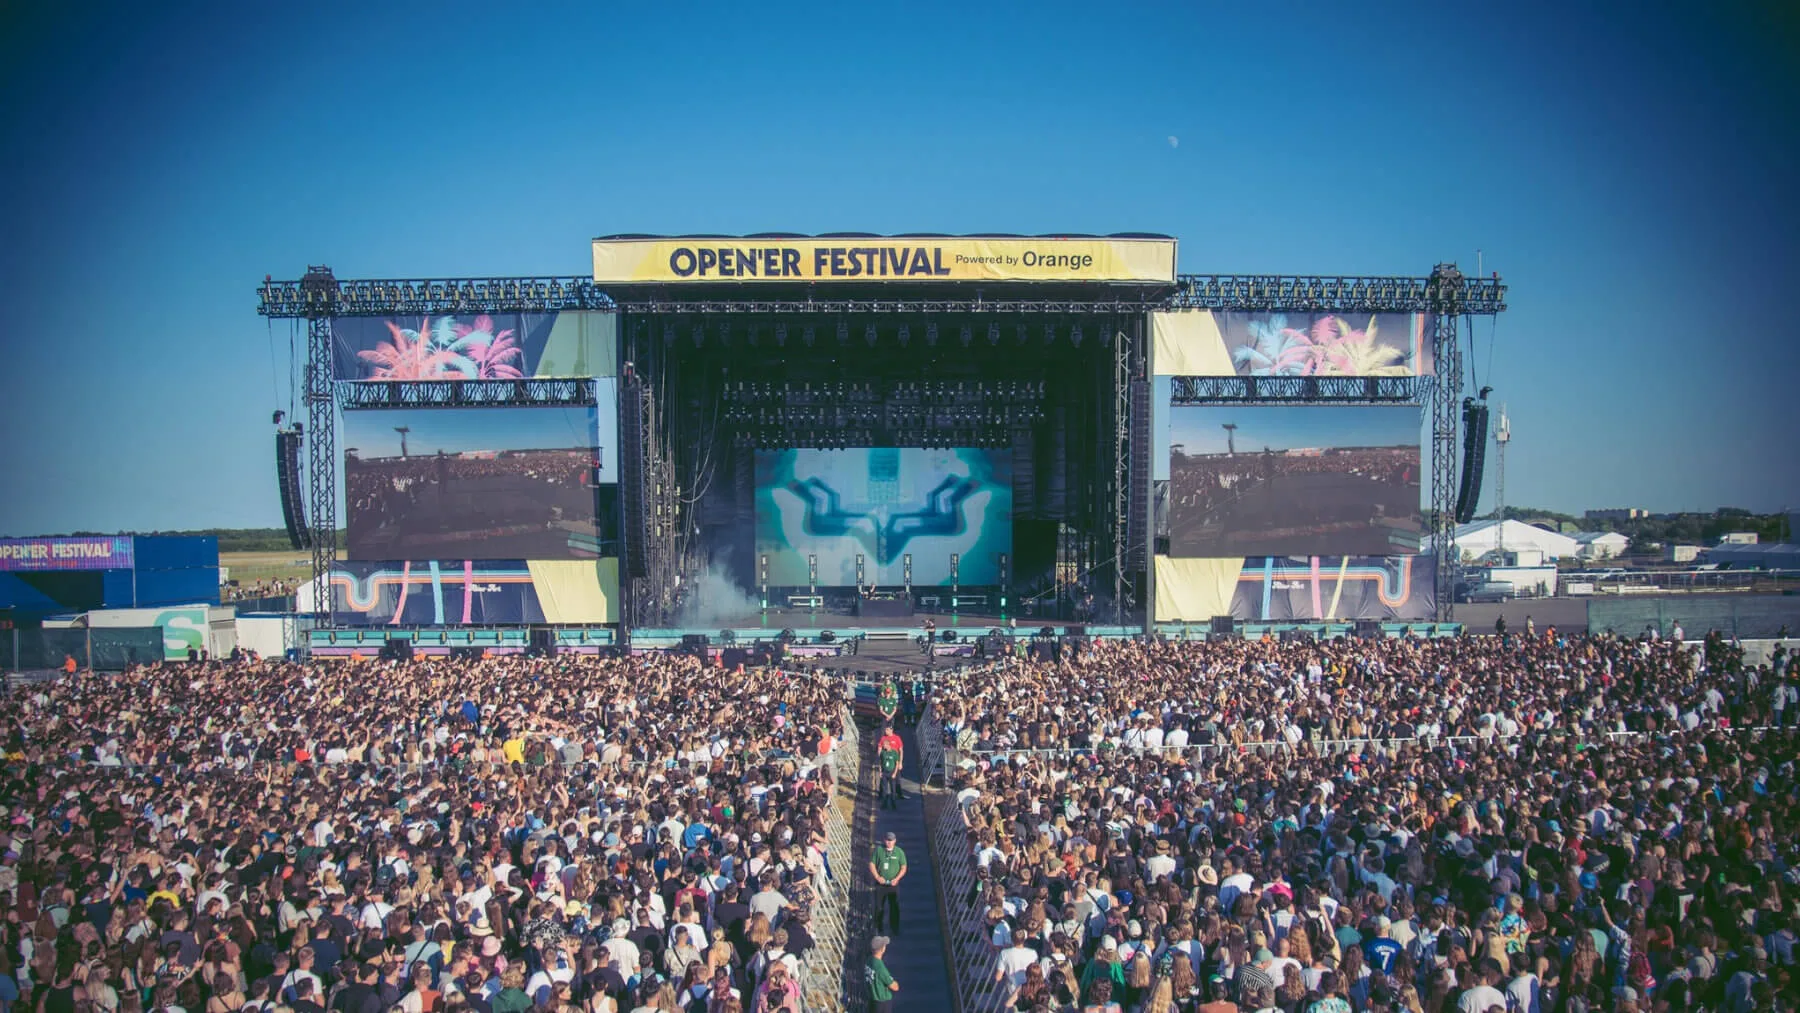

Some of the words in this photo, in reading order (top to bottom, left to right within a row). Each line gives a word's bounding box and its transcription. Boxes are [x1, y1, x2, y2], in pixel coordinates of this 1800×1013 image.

[670, 247, 801, 277] OPEN'ER
[814, 247, 951, 276] FESTIVAL
[955, 254, 1003, 264] Powered
[1006, 255, 1018, 266] by
[1022, 251, 1093, 270] Orange
[0, 544, 48, 559] PEN'ER
[52, 543, 111, 558] FESTIVAL
[1380, 951, 1390, 970] 7
